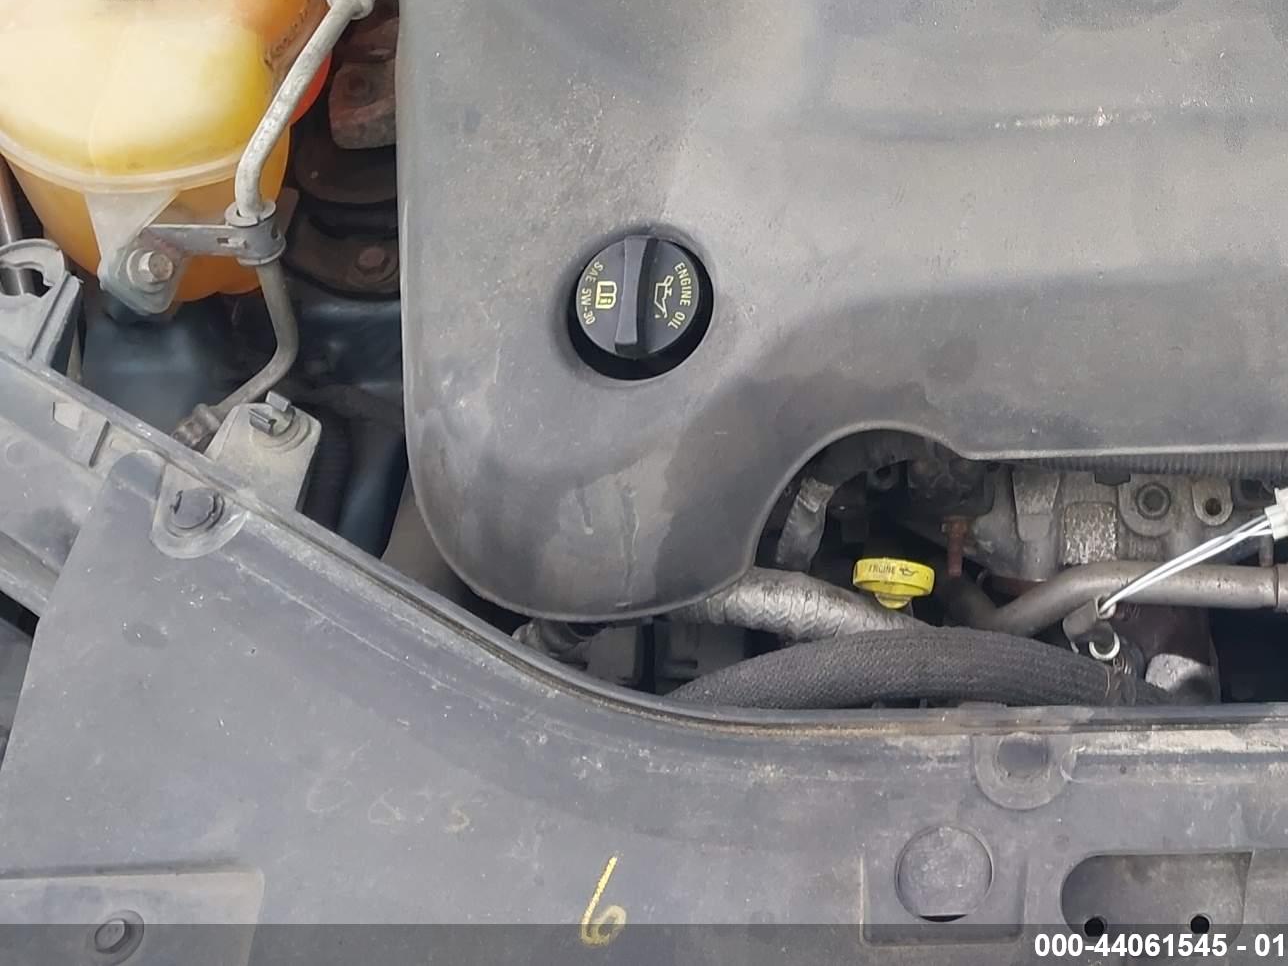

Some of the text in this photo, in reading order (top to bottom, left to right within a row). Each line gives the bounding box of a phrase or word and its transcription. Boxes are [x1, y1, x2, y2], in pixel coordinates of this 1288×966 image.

[580, 261, 604, 325] SAE 5W-30
[667, 261, 693, 330] ENGINE OIL
[579, 851, 628, 947] 6
